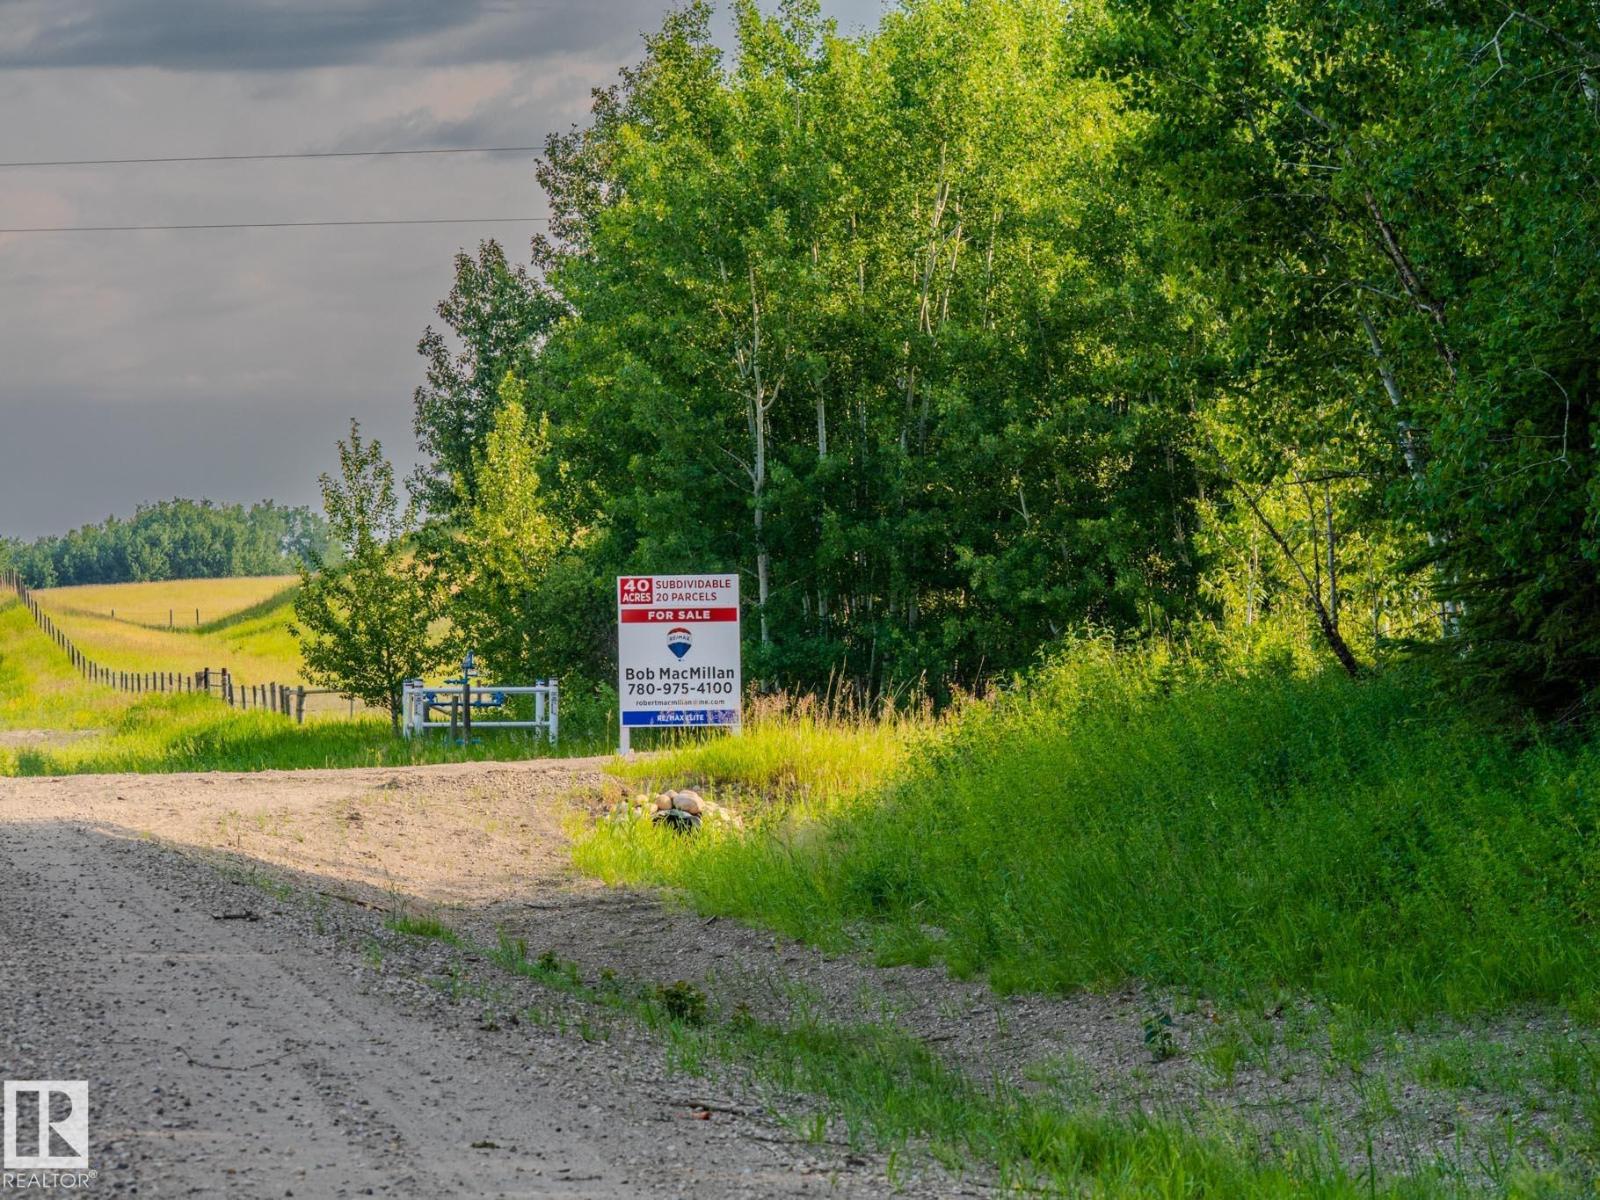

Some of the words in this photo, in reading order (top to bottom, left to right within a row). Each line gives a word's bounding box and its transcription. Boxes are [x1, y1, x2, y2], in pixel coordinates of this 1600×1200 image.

[623, 579, 650, 592] 40
[655, 579, 731, 589] SUBDIVIDABLE
[622, 592, 651, 602] ACRES
[656, 592, 669, 602] 20
[671, 592, 717, 601] PARCELS
[648, 611, 674, 620] FOR
[678, 610, 711, 619] SALE
[625, 667, 655, 680] Bob
[659, 666, 735, 680] MacMillan
[628, 682, 733, 695] 780-975-4100
